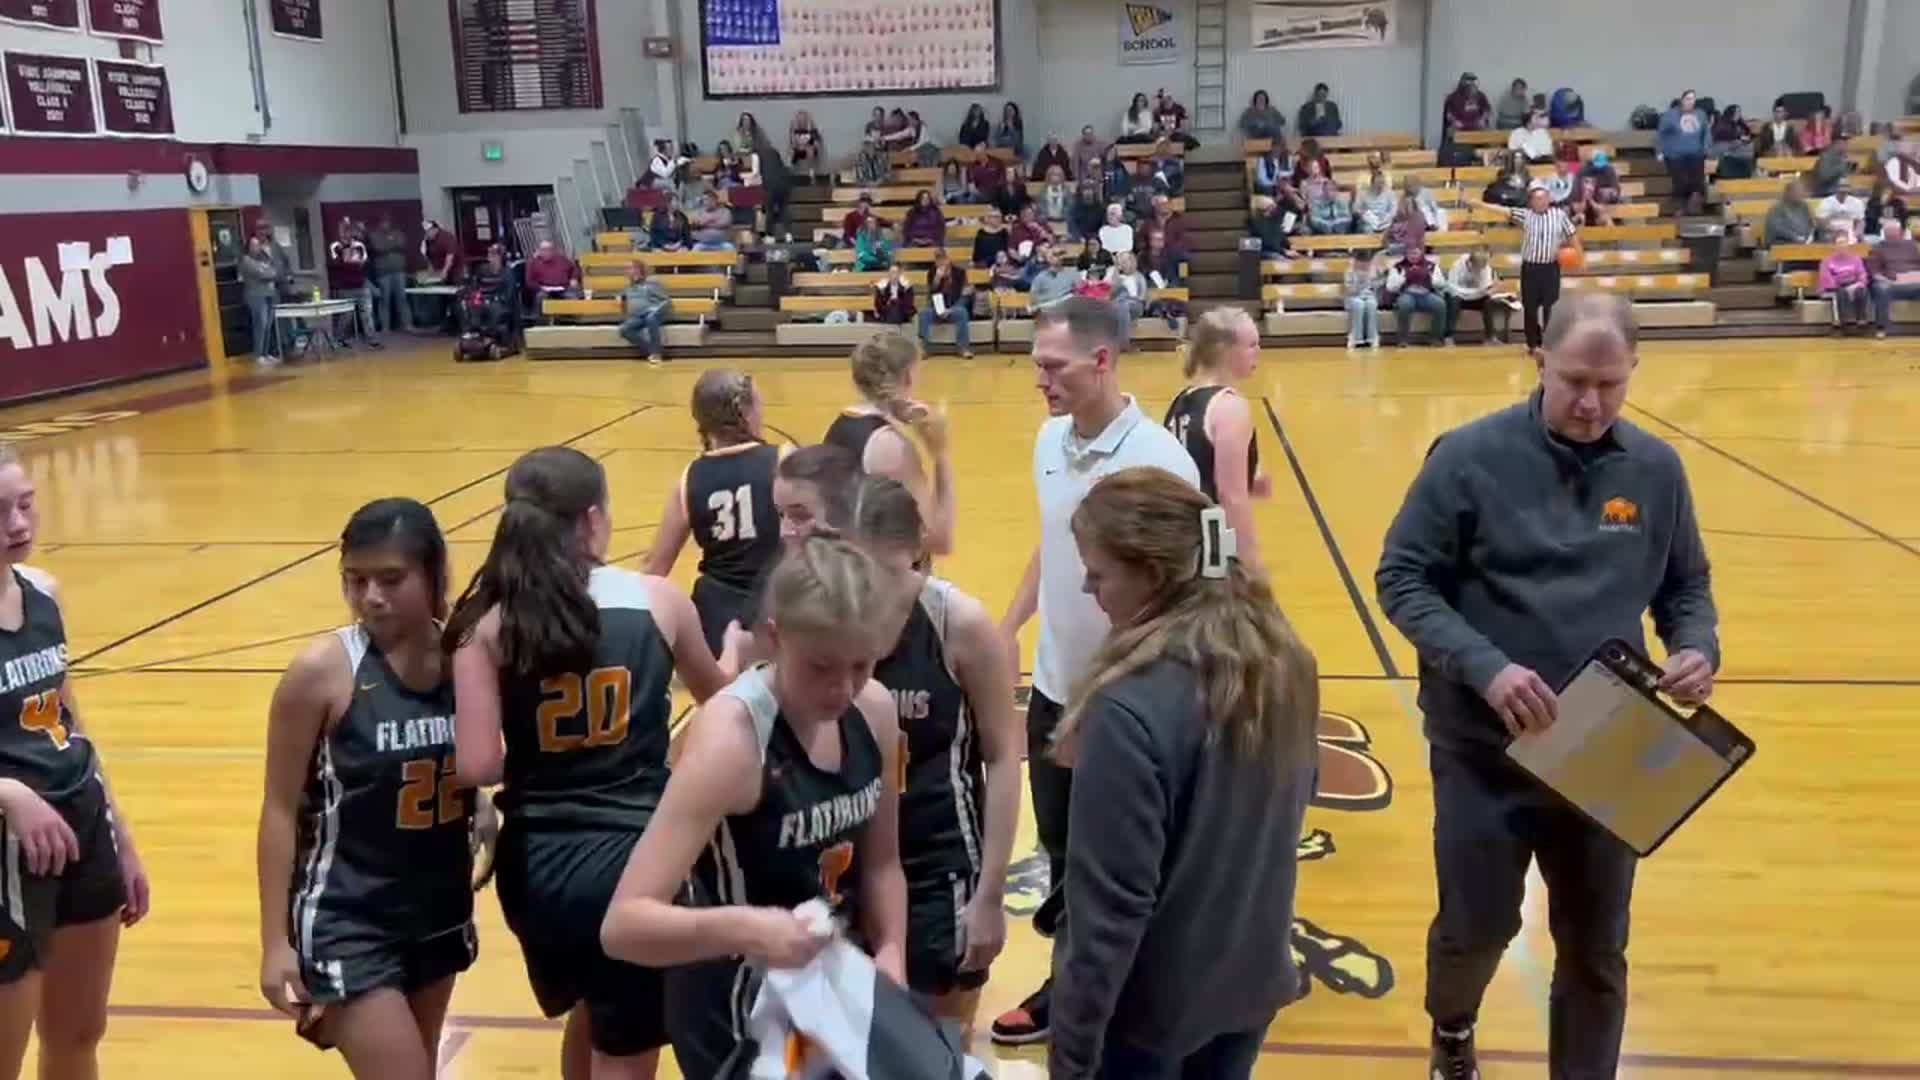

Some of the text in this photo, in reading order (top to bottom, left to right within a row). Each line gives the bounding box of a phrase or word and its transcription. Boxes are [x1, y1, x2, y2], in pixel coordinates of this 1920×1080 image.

[1123, 38, 1176, 51] SCHOOL
[708, 484, 757, 541] 31
[20, 688, 71, 751] 4
[536, 666, 632, 752] 20
[396, 756, 465, 830] 22
